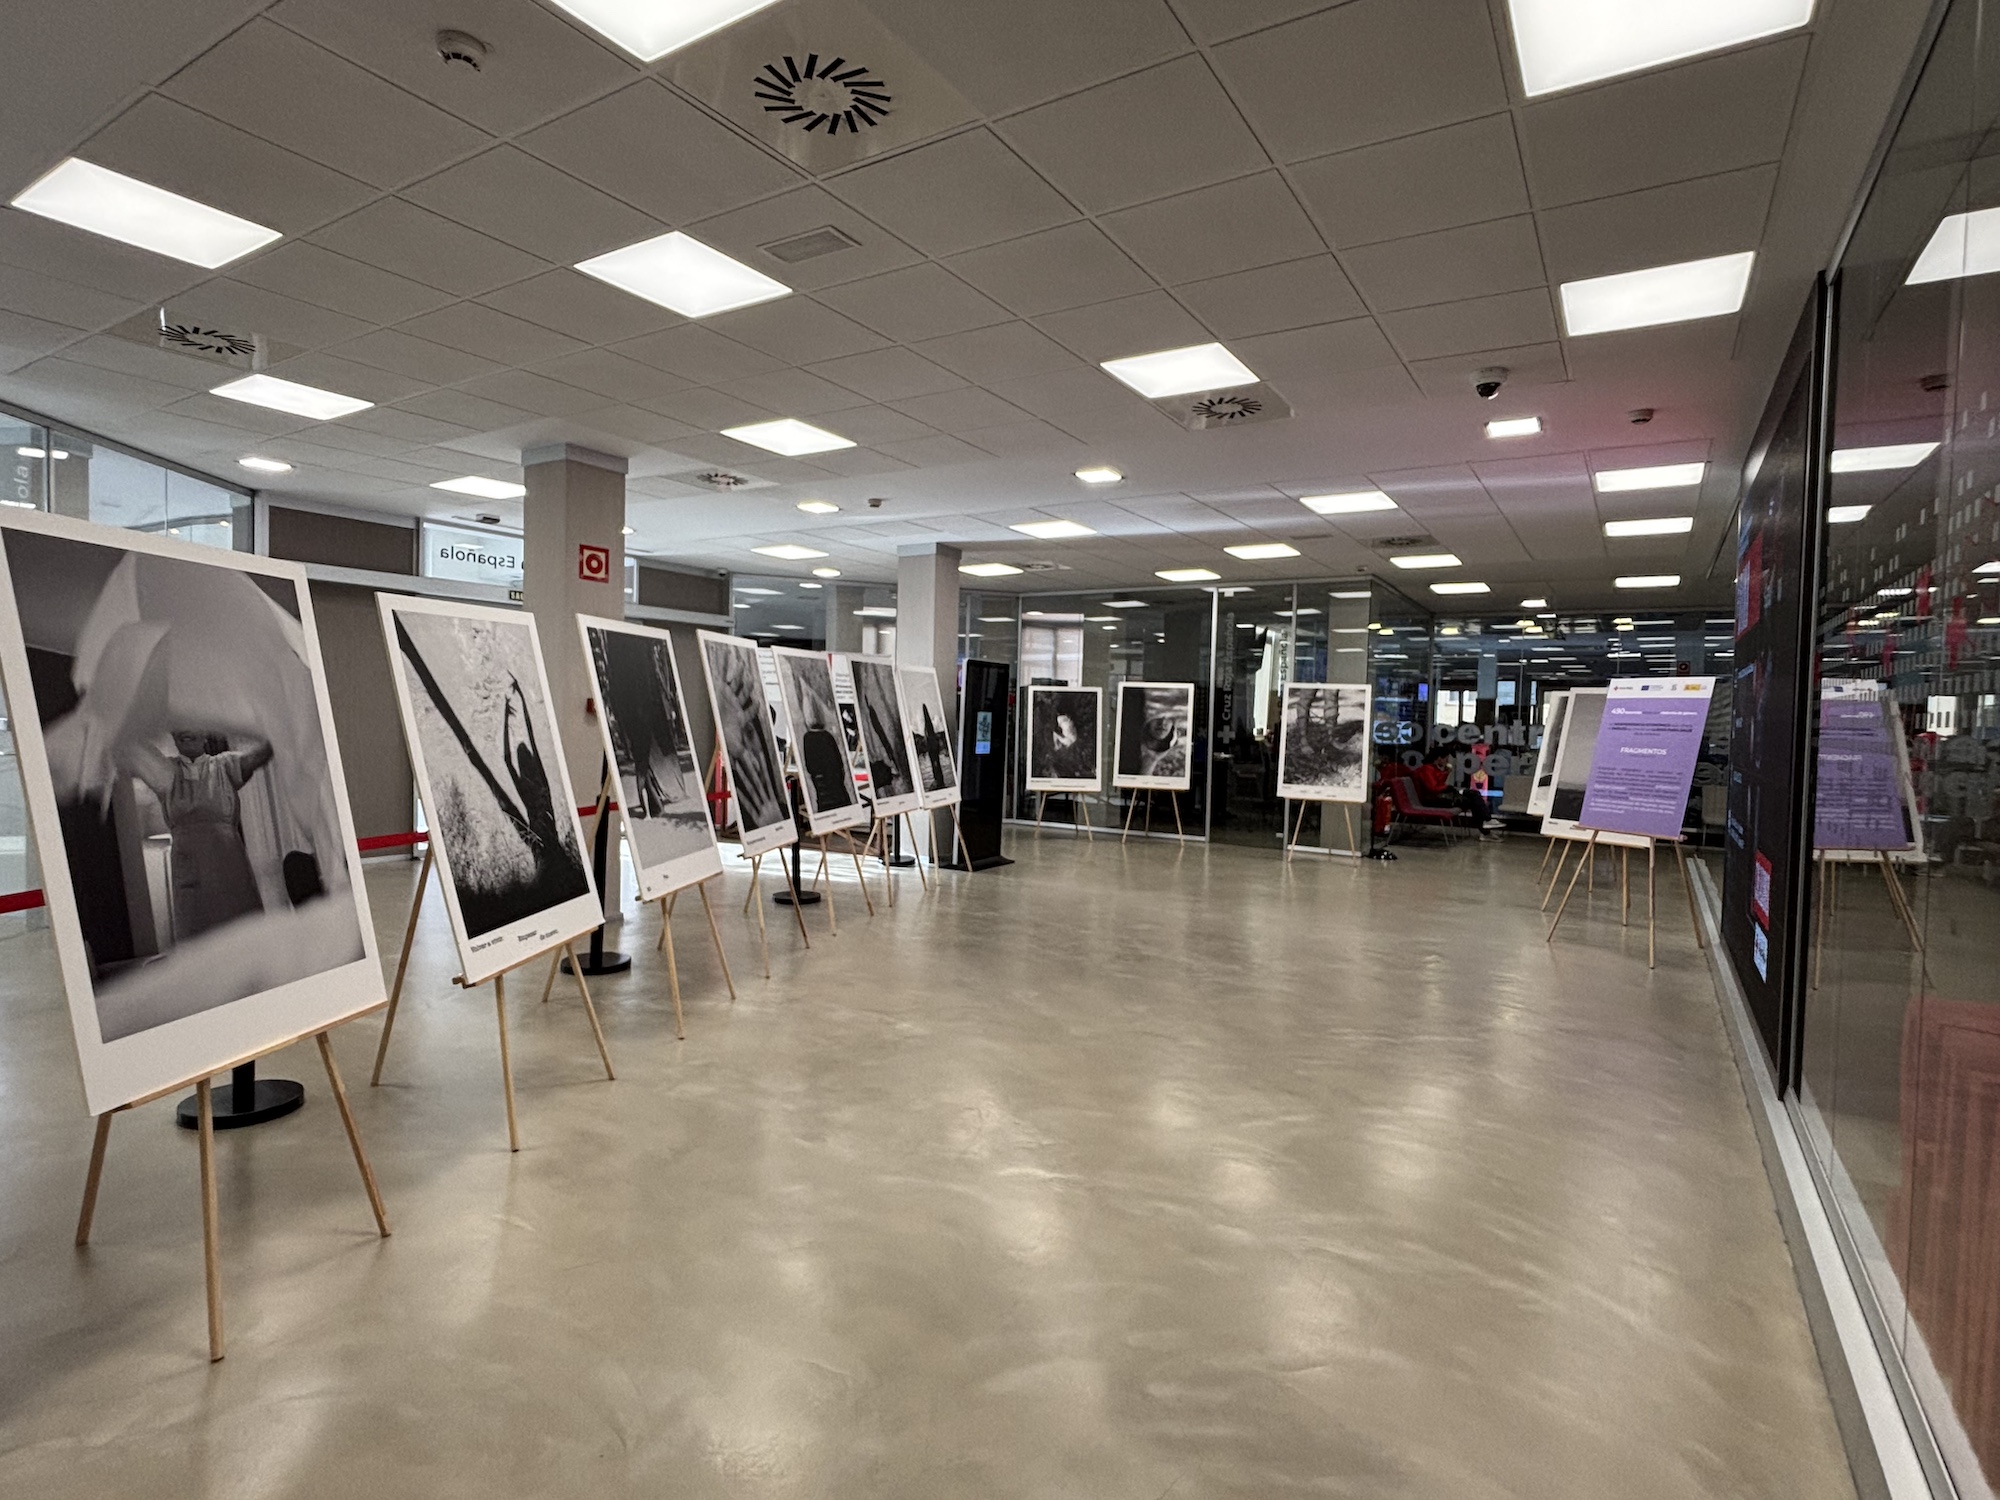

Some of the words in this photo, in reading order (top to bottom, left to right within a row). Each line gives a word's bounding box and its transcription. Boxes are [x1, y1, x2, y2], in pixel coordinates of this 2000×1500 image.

[1222, 693, 1232, 721] Cruz
[1433, 719, 1545, 746] centr
[1620, 746, 1667, 755] FRAGMENTOS
